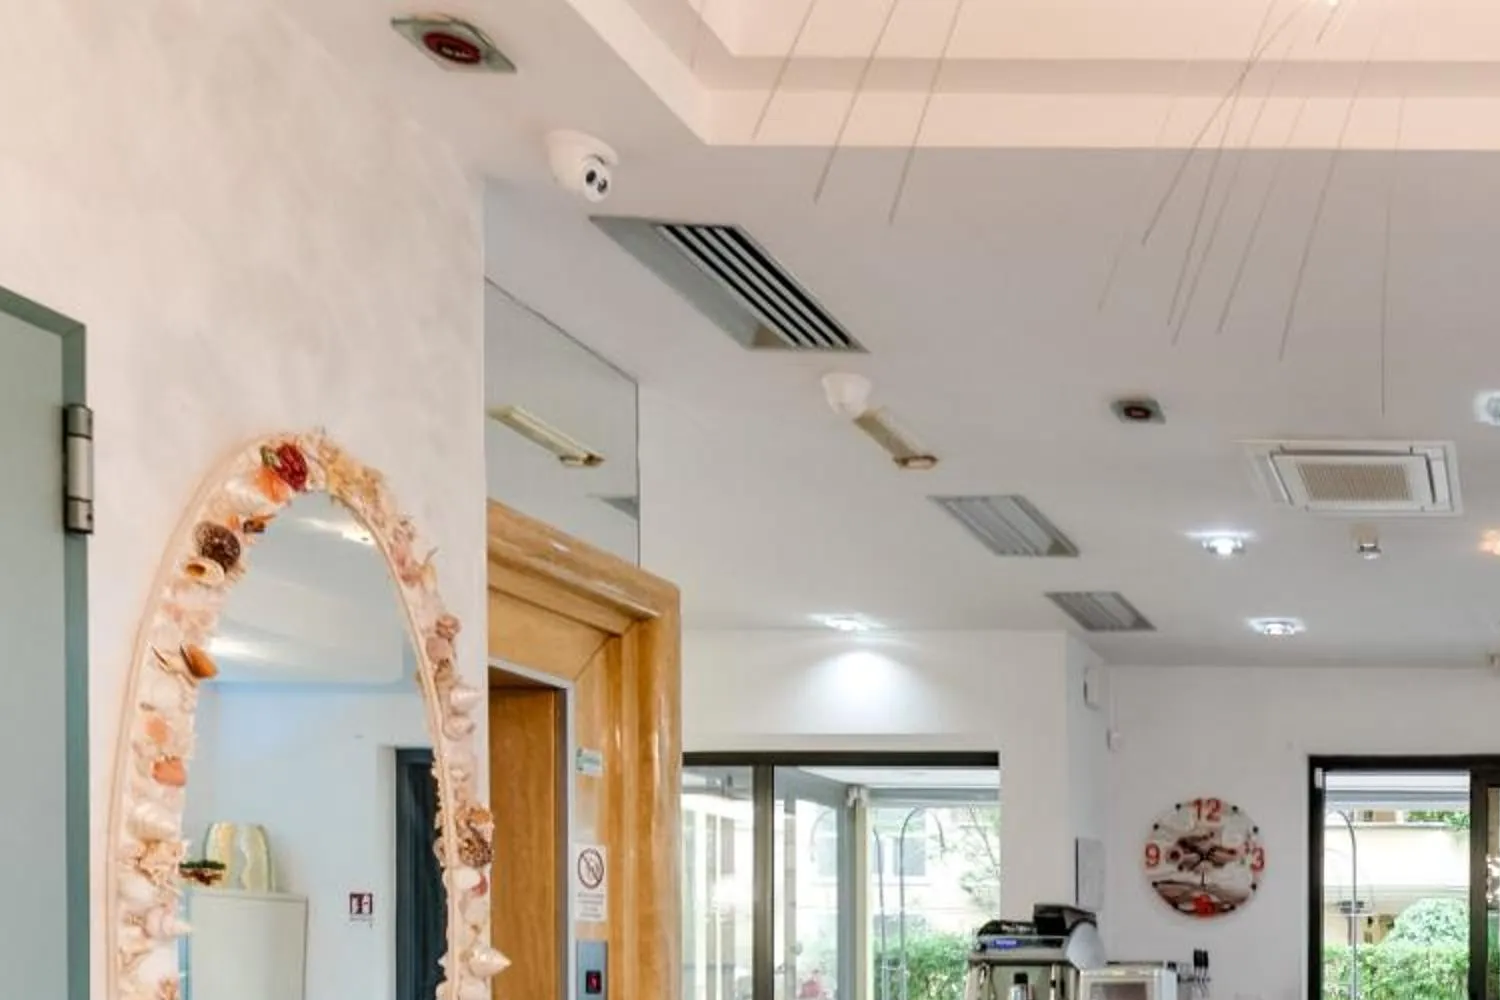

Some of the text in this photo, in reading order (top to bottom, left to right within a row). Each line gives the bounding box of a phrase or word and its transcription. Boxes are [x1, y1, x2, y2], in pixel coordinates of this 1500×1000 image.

[1191, 798, 1222, 822] 12
[1144, 843, 1160, 868] 9
[1250, 847, 1264, 873] 3
